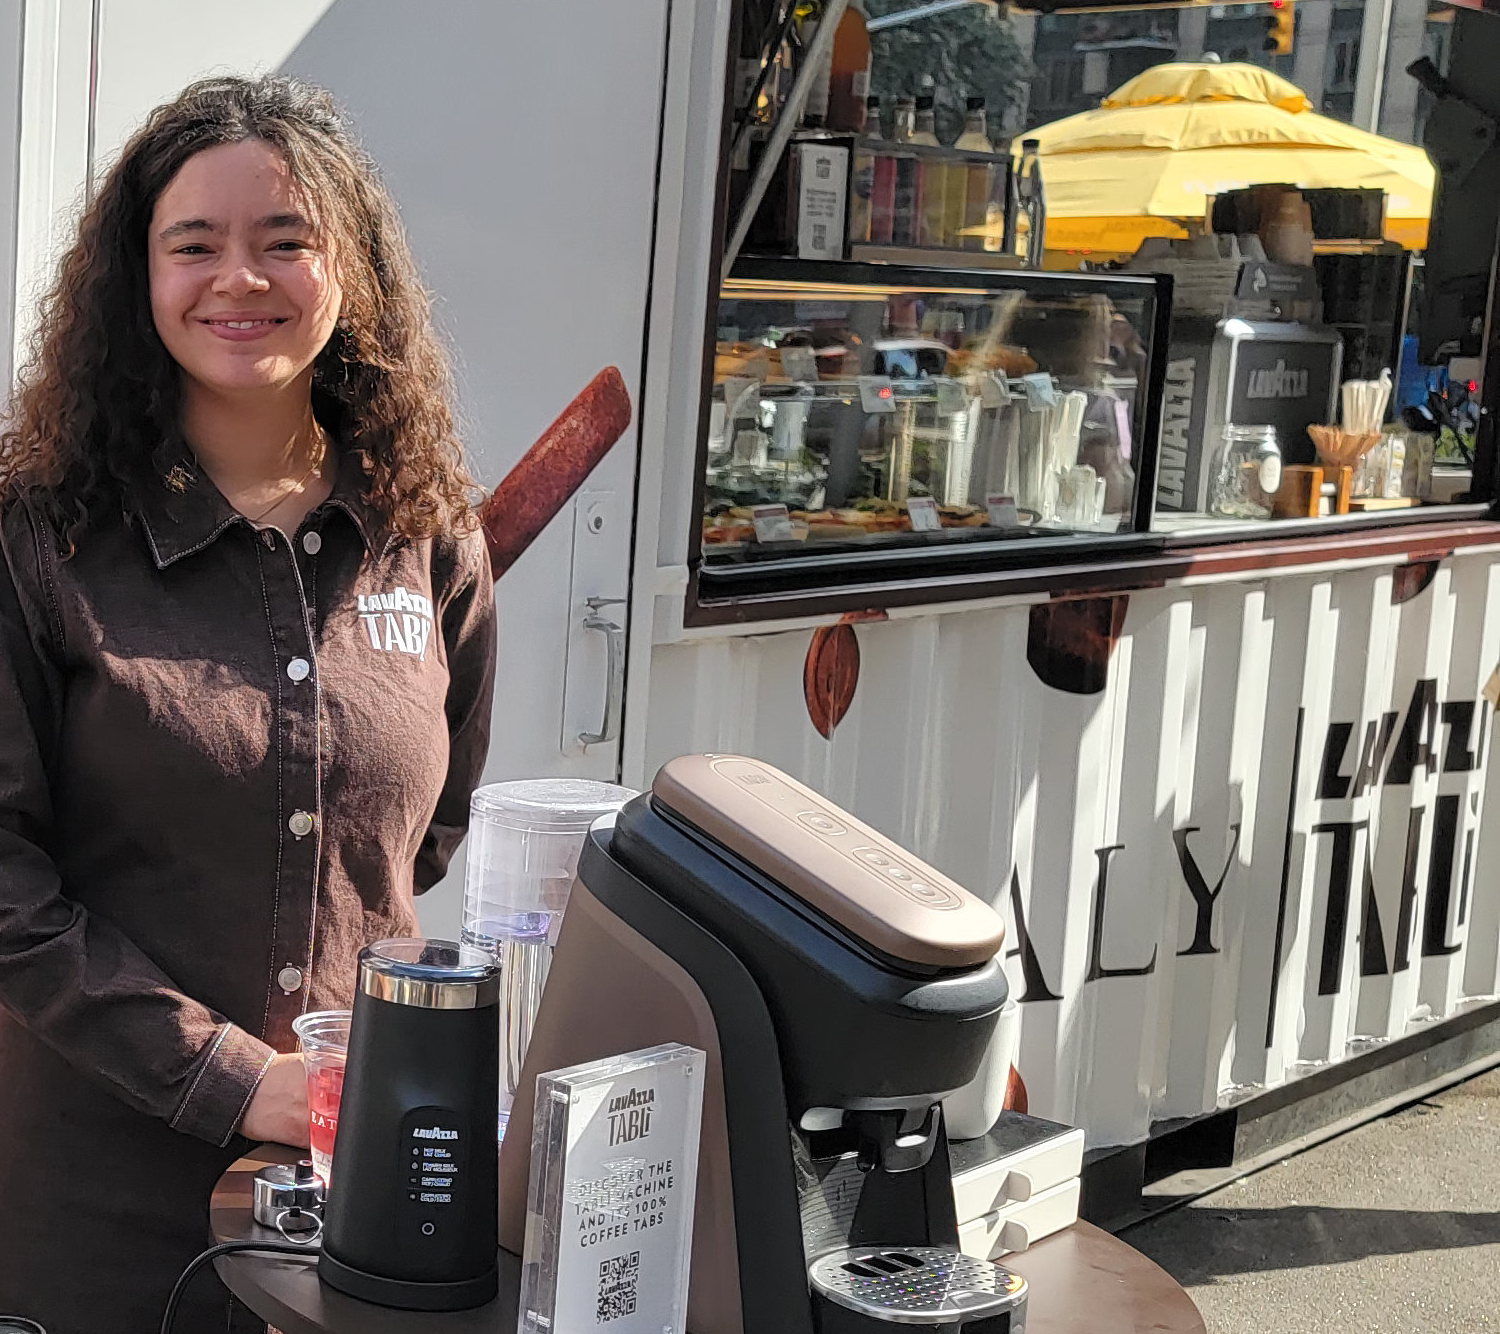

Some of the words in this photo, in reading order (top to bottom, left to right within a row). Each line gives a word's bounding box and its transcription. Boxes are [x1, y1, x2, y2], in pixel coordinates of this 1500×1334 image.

[608, 1087, 655, 1113] LAVAZZA
[412, 1127, 459, 1140] LAVAZZA
[649, 1160, 672, 1177] THE
[579, 1212, 606, 1232] AND
[635, 1195, 667, 1213] 100%
[580, 1223, 628, 1247] COFFEE
[633, 1211, 664, 1232] TABS
